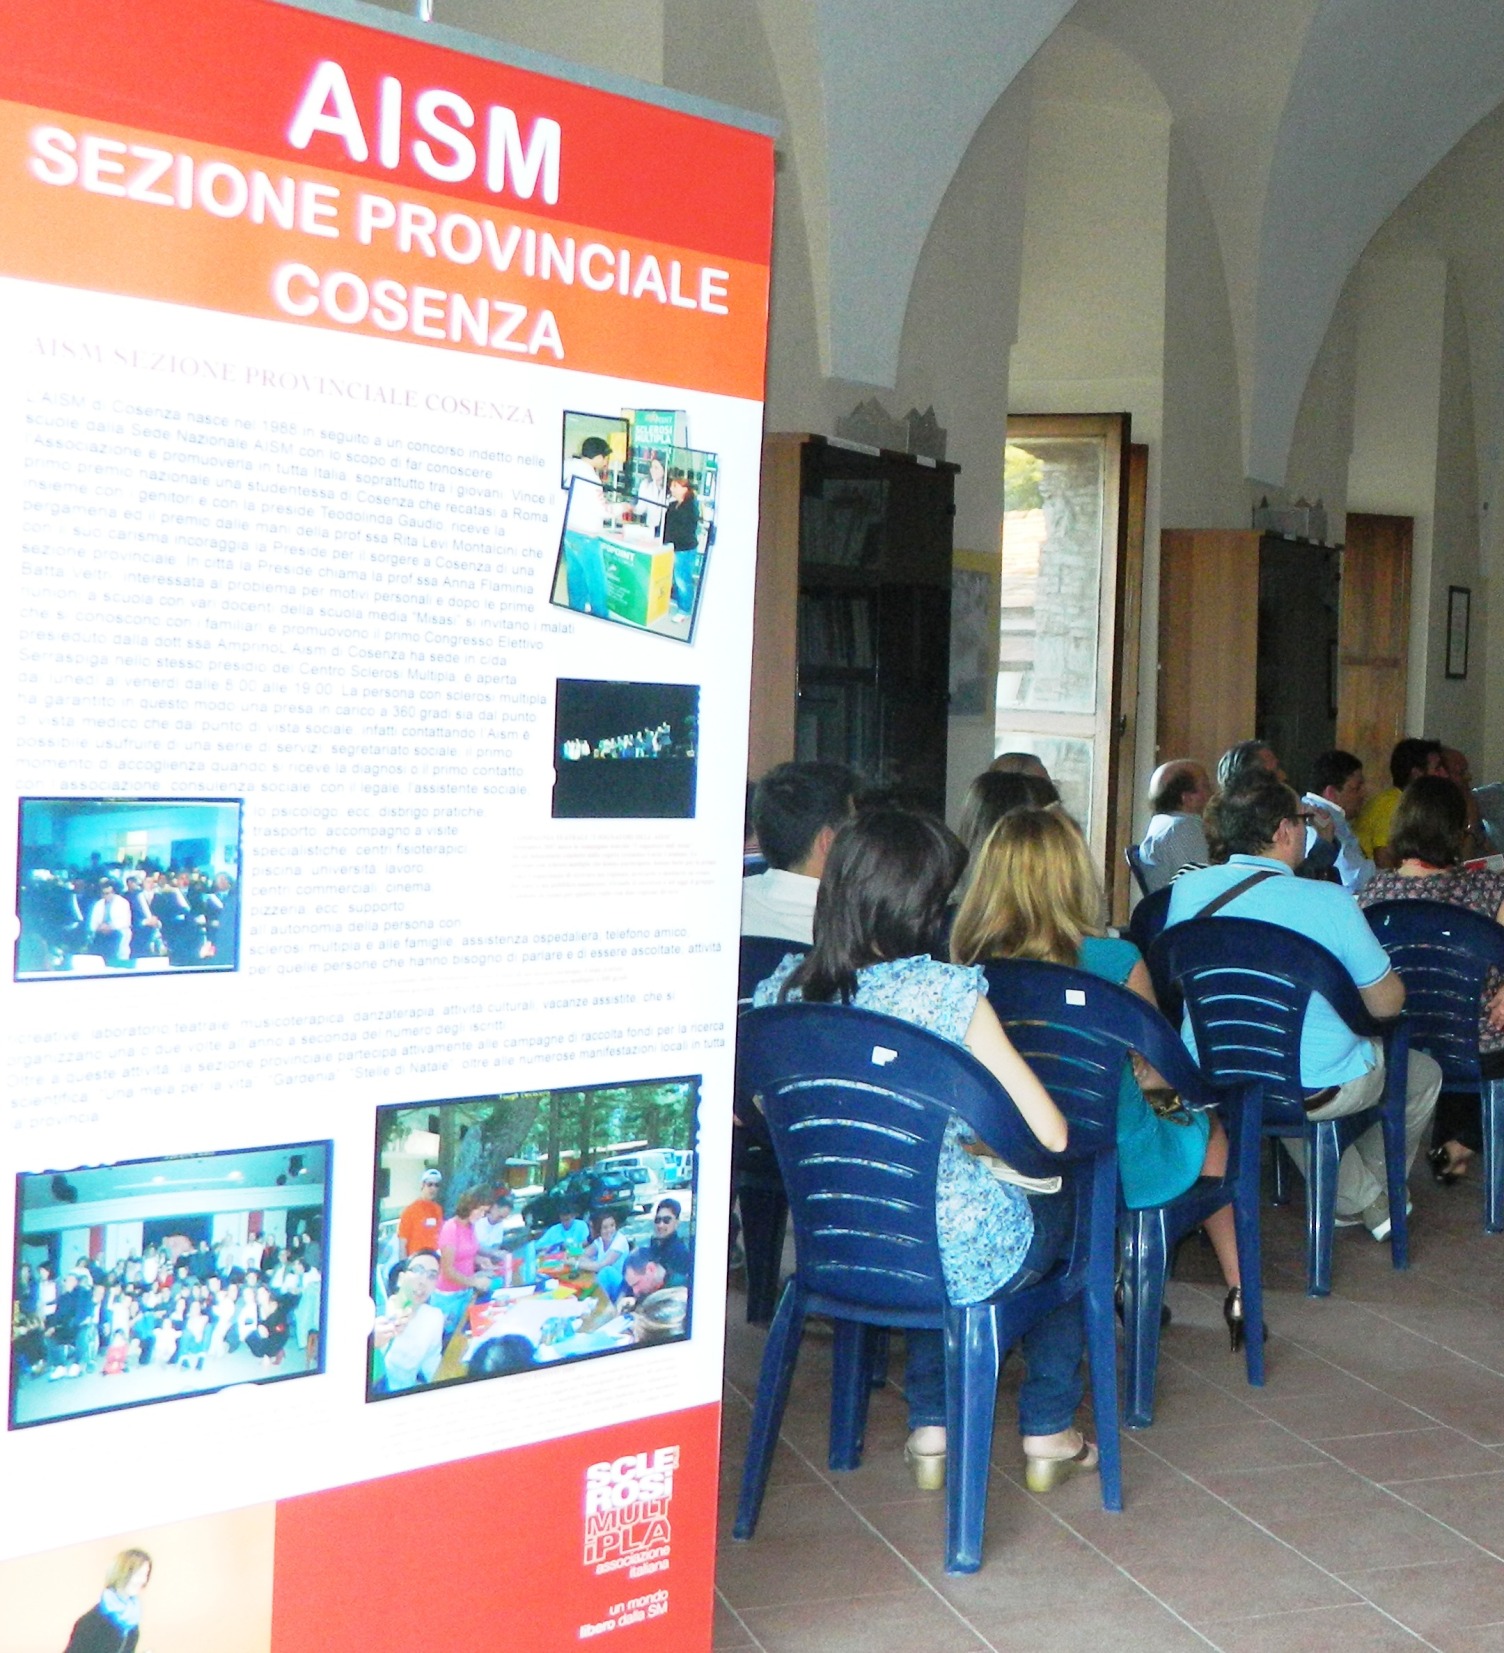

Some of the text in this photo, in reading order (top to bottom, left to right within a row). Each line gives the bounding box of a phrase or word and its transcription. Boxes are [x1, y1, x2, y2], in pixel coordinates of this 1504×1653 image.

[288, 61, 561, 204] AISM
[28, 126, 730, 315] SEZIONE PROVINCIALE
[273, 263, 565, 359] COSENZA
[30, 333, 535, 423] AISM SEZIONE PROVINCIALE COSENZA
[586, 1445, 680, 1489] SCLE
[586, 1499, 670, 1543] MULT
[596, 1544, 670, 1575] associazione
[629, 1558, 669, 1579] italiana
[579, 1601, 668, 1639] libero dalla SM
[609, 1589, 669, 1615] un mondo
